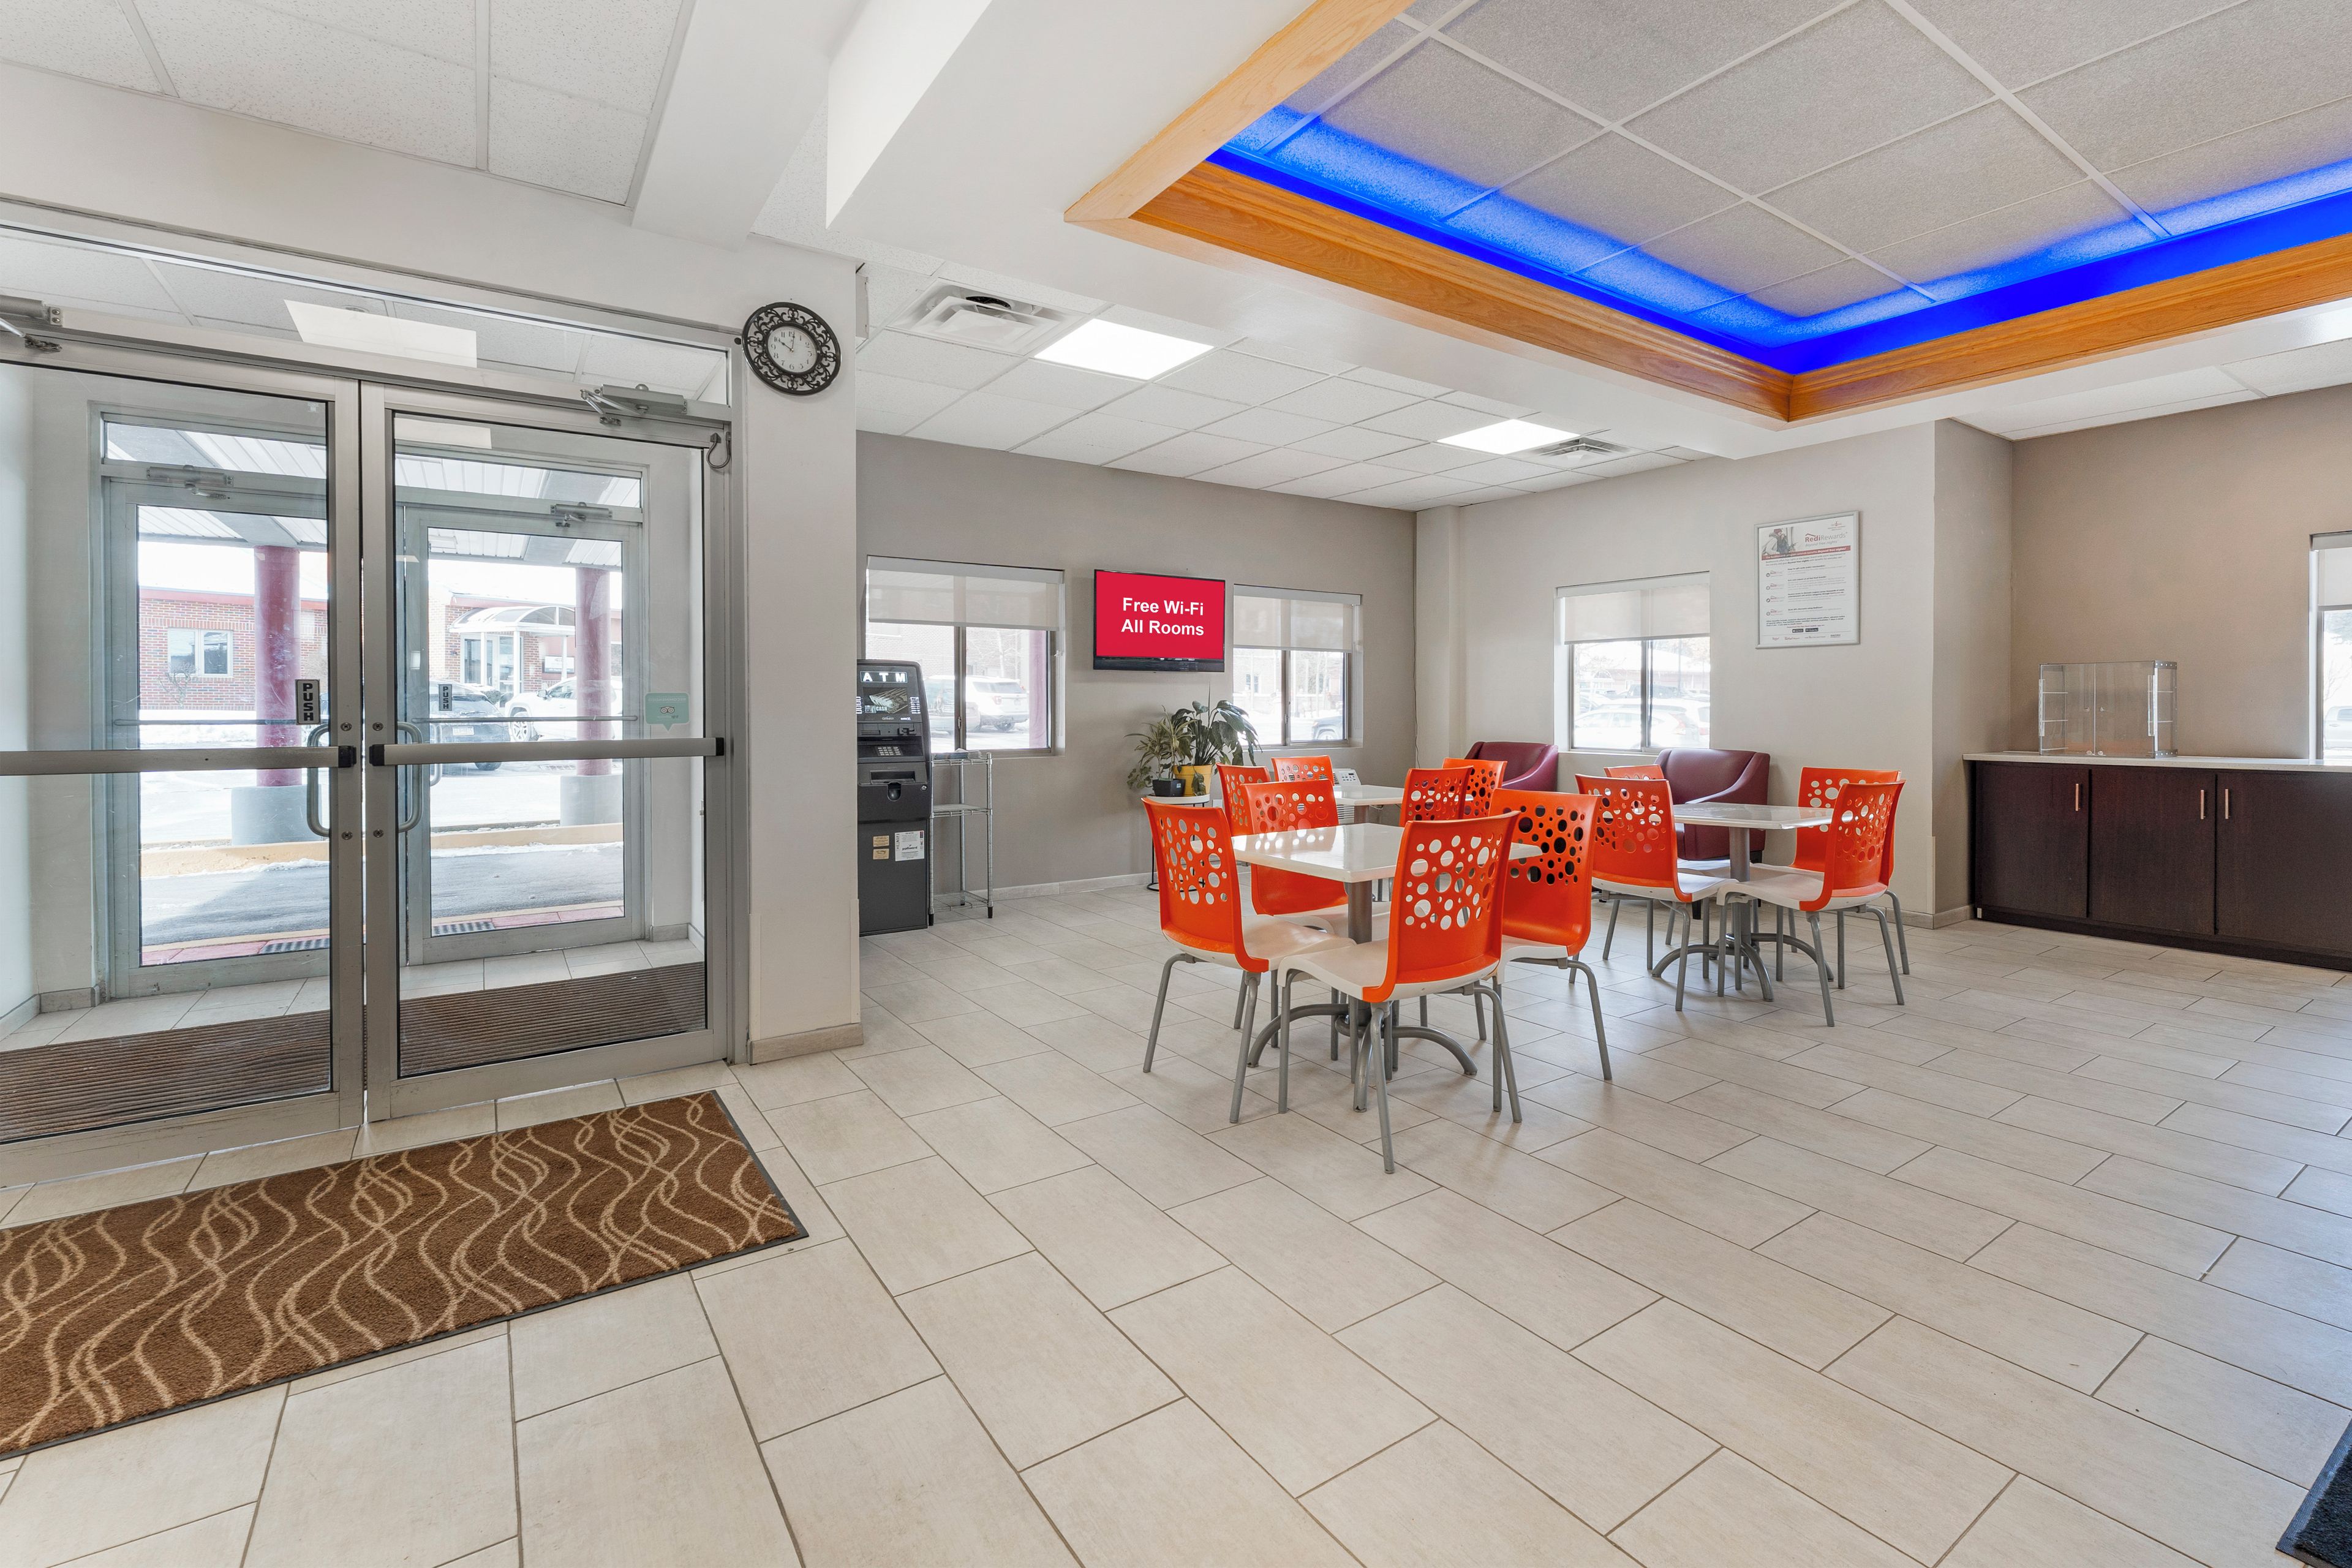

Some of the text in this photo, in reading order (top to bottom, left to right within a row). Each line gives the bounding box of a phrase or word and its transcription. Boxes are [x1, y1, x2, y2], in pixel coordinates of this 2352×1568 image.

[1123, 597, 1204, 616] Free Wi-Fi
[1121, 619, 1204, 636] All Rooms
[862, 672, 906, 682] ATM
[303, 683, 314, 721] PUSH
